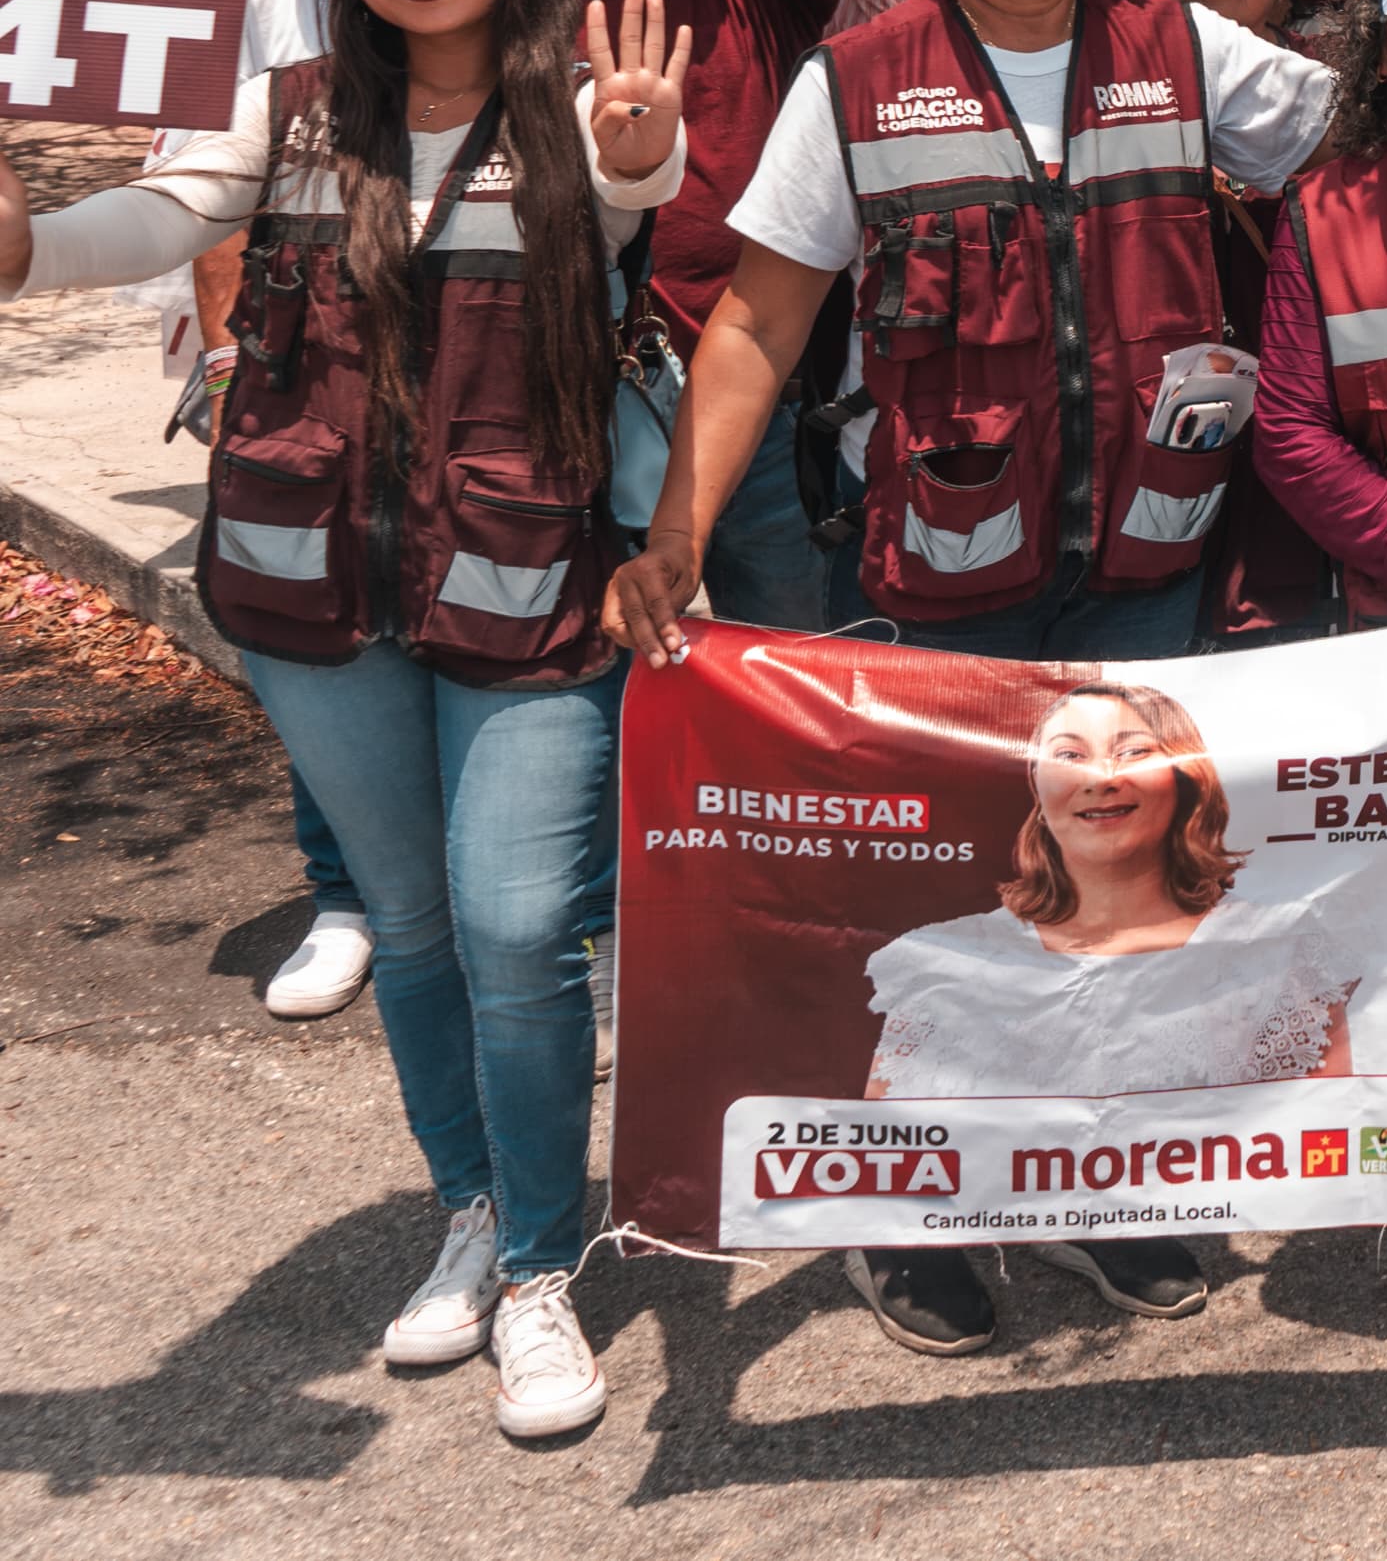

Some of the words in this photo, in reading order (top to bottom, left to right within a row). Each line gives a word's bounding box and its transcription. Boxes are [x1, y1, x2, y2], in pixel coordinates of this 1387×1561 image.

[877, 98, 983, 119] HUACHO
[898, 86, 958, 101] SEGURO
[697, 786, 925, 828] BIENESTAR
[645, 828, 728, 851] PARA
[736, 830, 833, 858] TODAS
[842, 839, 861, 859] Y
[869, 841, 975, 863] TODOS
[767, 1123, 786, 1145] 2
[799, 1123, 838, 1145] DE
[848, 1124, 949, 1147] JUNIO
[760, 1151, 955, 1195] VOTA
[1011, 1131, 1289, 1193] morena
[1306, 1148, 1345, 1175] PT
[923, 1210, 1038, 1230] Candidata
[1044, 1214, 1057, 1227] a
[1064, 1206, 1167, 1230] Diputada
[1174, 1202, 1237, 1221] Local.
